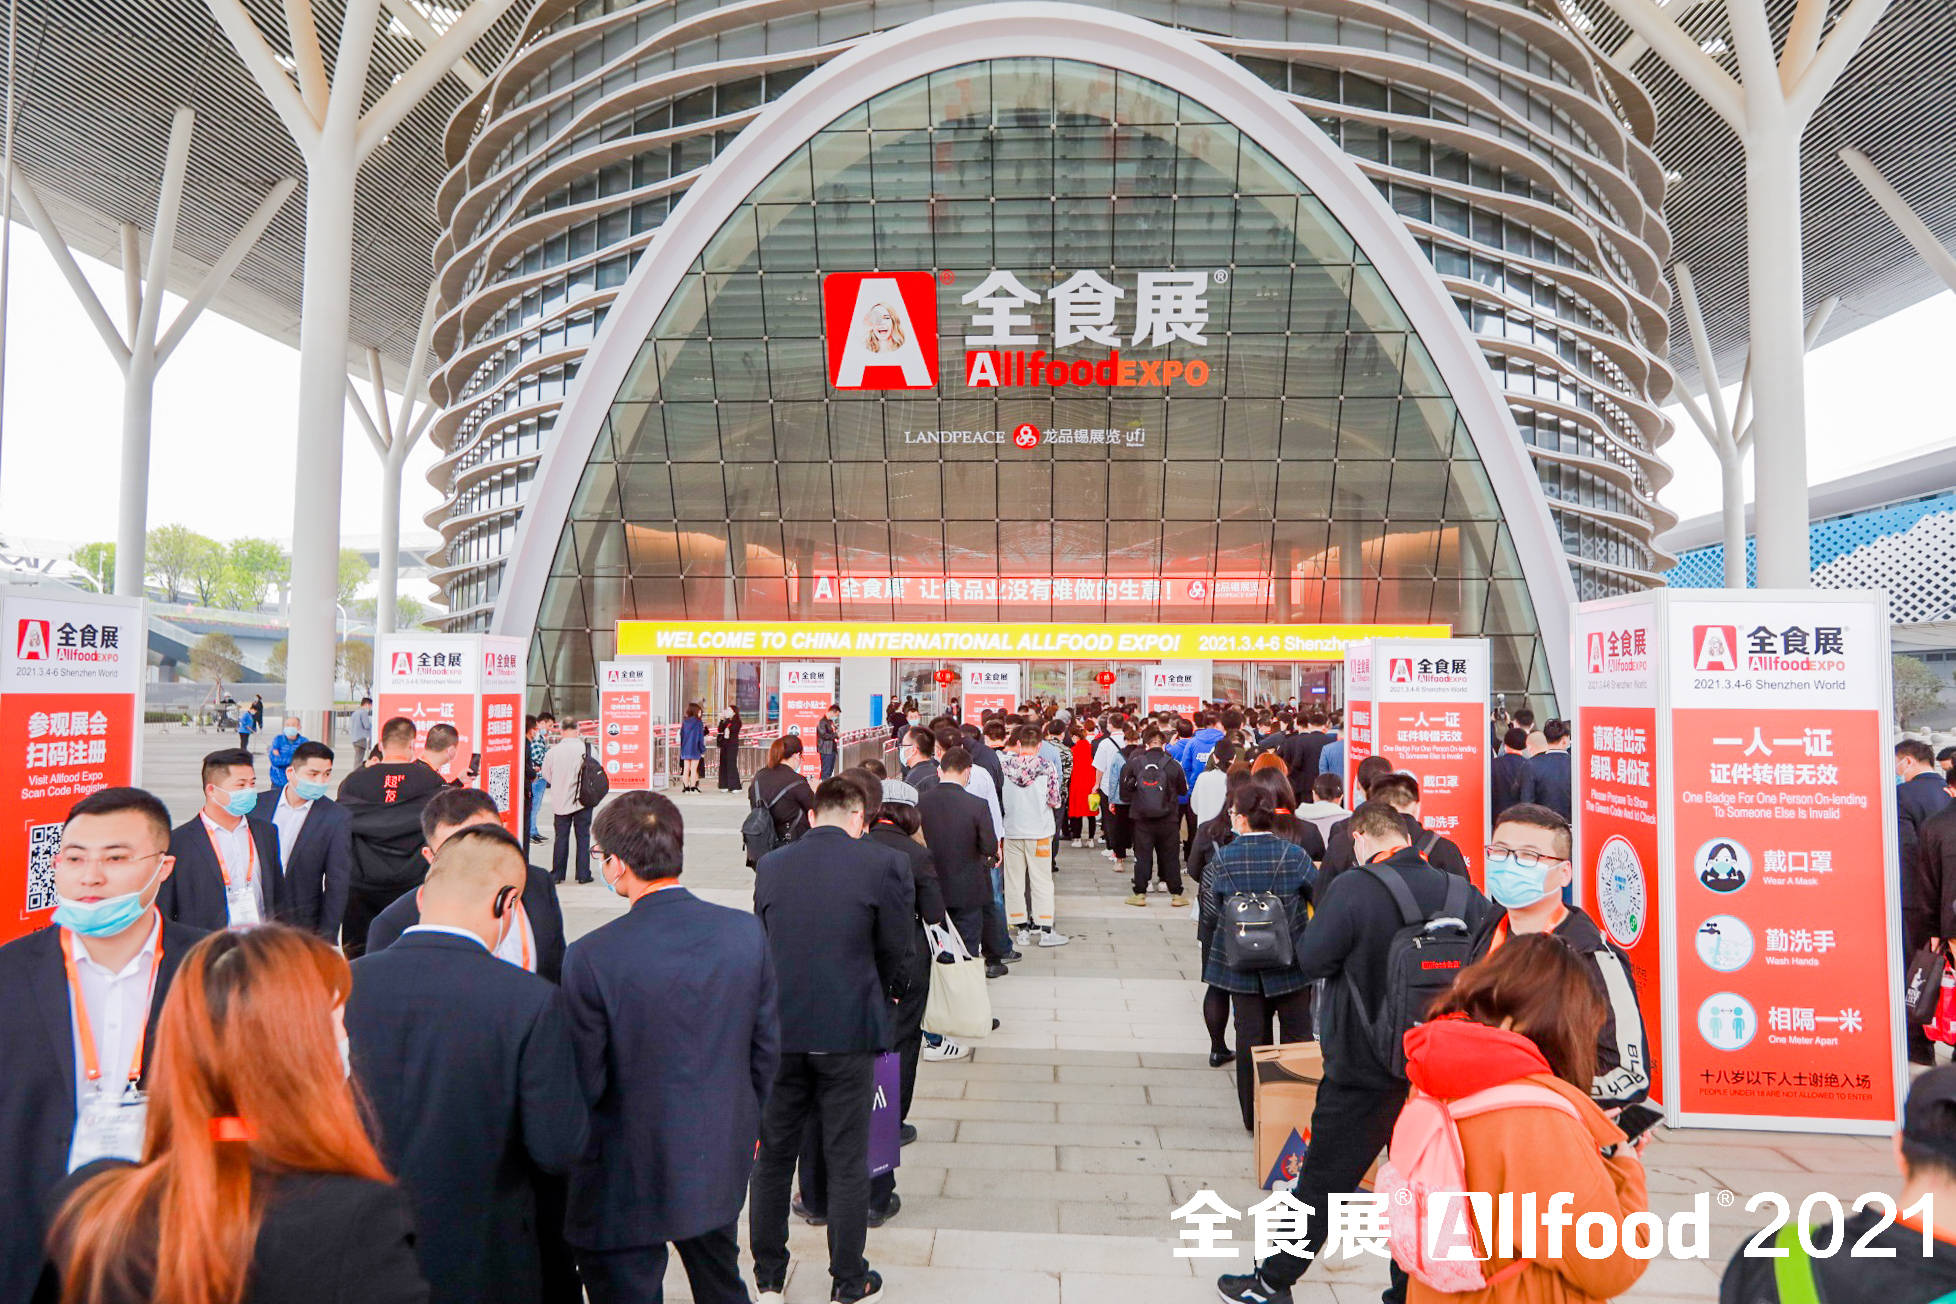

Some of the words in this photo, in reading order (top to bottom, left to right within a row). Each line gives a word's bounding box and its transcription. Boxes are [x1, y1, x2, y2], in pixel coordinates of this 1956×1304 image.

[904, 430, 1005, 444] LANDPEACE
[1042, 429, 1120, 444] 龙品锡展览
[57, 622, 118, 648] 全食展
[656, 632, 756, 650] WELCOME
[761, 632, 786, 650] TO
[791, 633, 851, 650] CHINA
[855, 633, 1017, 651] INTERNATIONAL
[1022, 634, 1117, 653] ALLFOOD
[1119, 634, 1181, 653] EXPO!
[1198, 635, 1281, 651] 2021.3.4-6
[1607, 628, 1646, 657] 全食展
[1746, 625, 1844, 656] 全食展
[417, 652, 462, 667] 全食展
[1417, 658, 1467, 674] 全食展
[16, 666, 59, 676] 2021.3.4-6
[60, 667, 97, 677] Shenzhen
[98, 668, 118, 678] World
[1694, 679, 1753, 690] 2021.3.4-6
[1755, 679, 1811, 690] Shenzhen
[1813, 680, 1846, 690] World
[398, 702, 455, 719] 一人一证
[28, 711, 108, 739] 参观展会
[1398, 711, 1460, 728] 一人一证
[1592, 725, 1647, 755] 请预备出示
[1712, 727, 1834, 758] 一人一证
[26, 739, 107, 768] 扫码注册
[28, 775, 49, 786] Visit
[49, 773, 80, 785] Allfood
[81, 771, 104, 785] Expo
[1709, 762, 1839, 786] 证件转借无效
[21, 788, 46, 800] Scan
[47, 785, 72, 797] Code
[1683, 791, 1703, 803] One
[1705, 791, 1736, 806] Badge
[1738, 792, 1754, 804] For
[1756, 792, 1777, 804] One
[1779, 792, 1813, 805] Person
[1814, 793, 1867, 808] On-lending
[1713, 806, 1723, 817] To
[1727, 806, 1772, 818] Someone
[1774, 807, 1796, 819] Else
[1809, 807, 1840, 819] Invalid
[1763, 850, 1833, 873] 戴口罩
[1765, 928, 1836, 953] 勤洗手
[1765, 956, 1789, 966] Wash
[1791, 957, 1820, 966] Hands
[1768, 1006, 1863, 1032] 相隔一米
[1768, 1035, 1786, 1044] One
[1815, 1037, 1839, 1047] Apart
[1700, 1069, 1871, 1090] 十八岁以下人士谢绝入场
